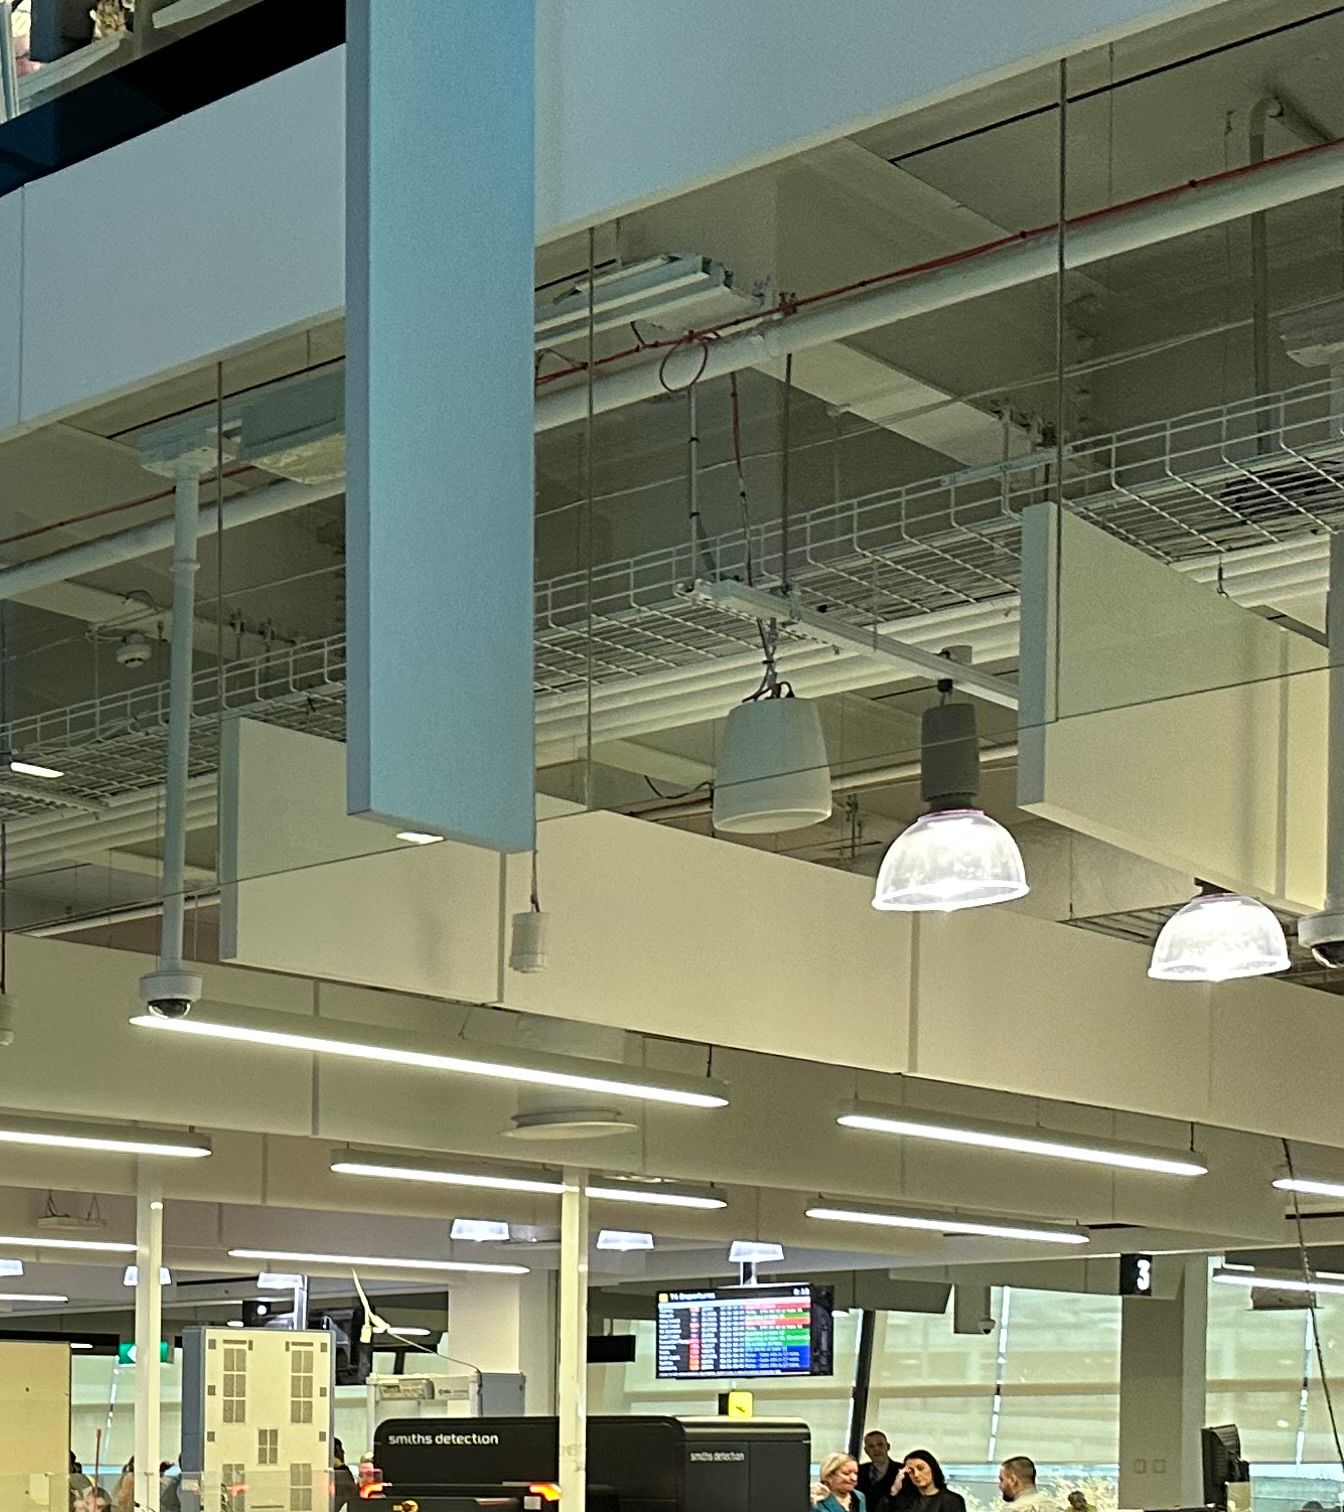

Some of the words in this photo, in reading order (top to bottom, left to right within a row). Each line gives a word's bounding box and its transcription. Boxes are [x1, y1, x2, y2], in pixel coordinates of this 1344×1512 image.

[1137, 1259, 1150, 1290] 3
[388, 1433, 433, 1445] smiths
[435, 1433, 499, 1445] detection
